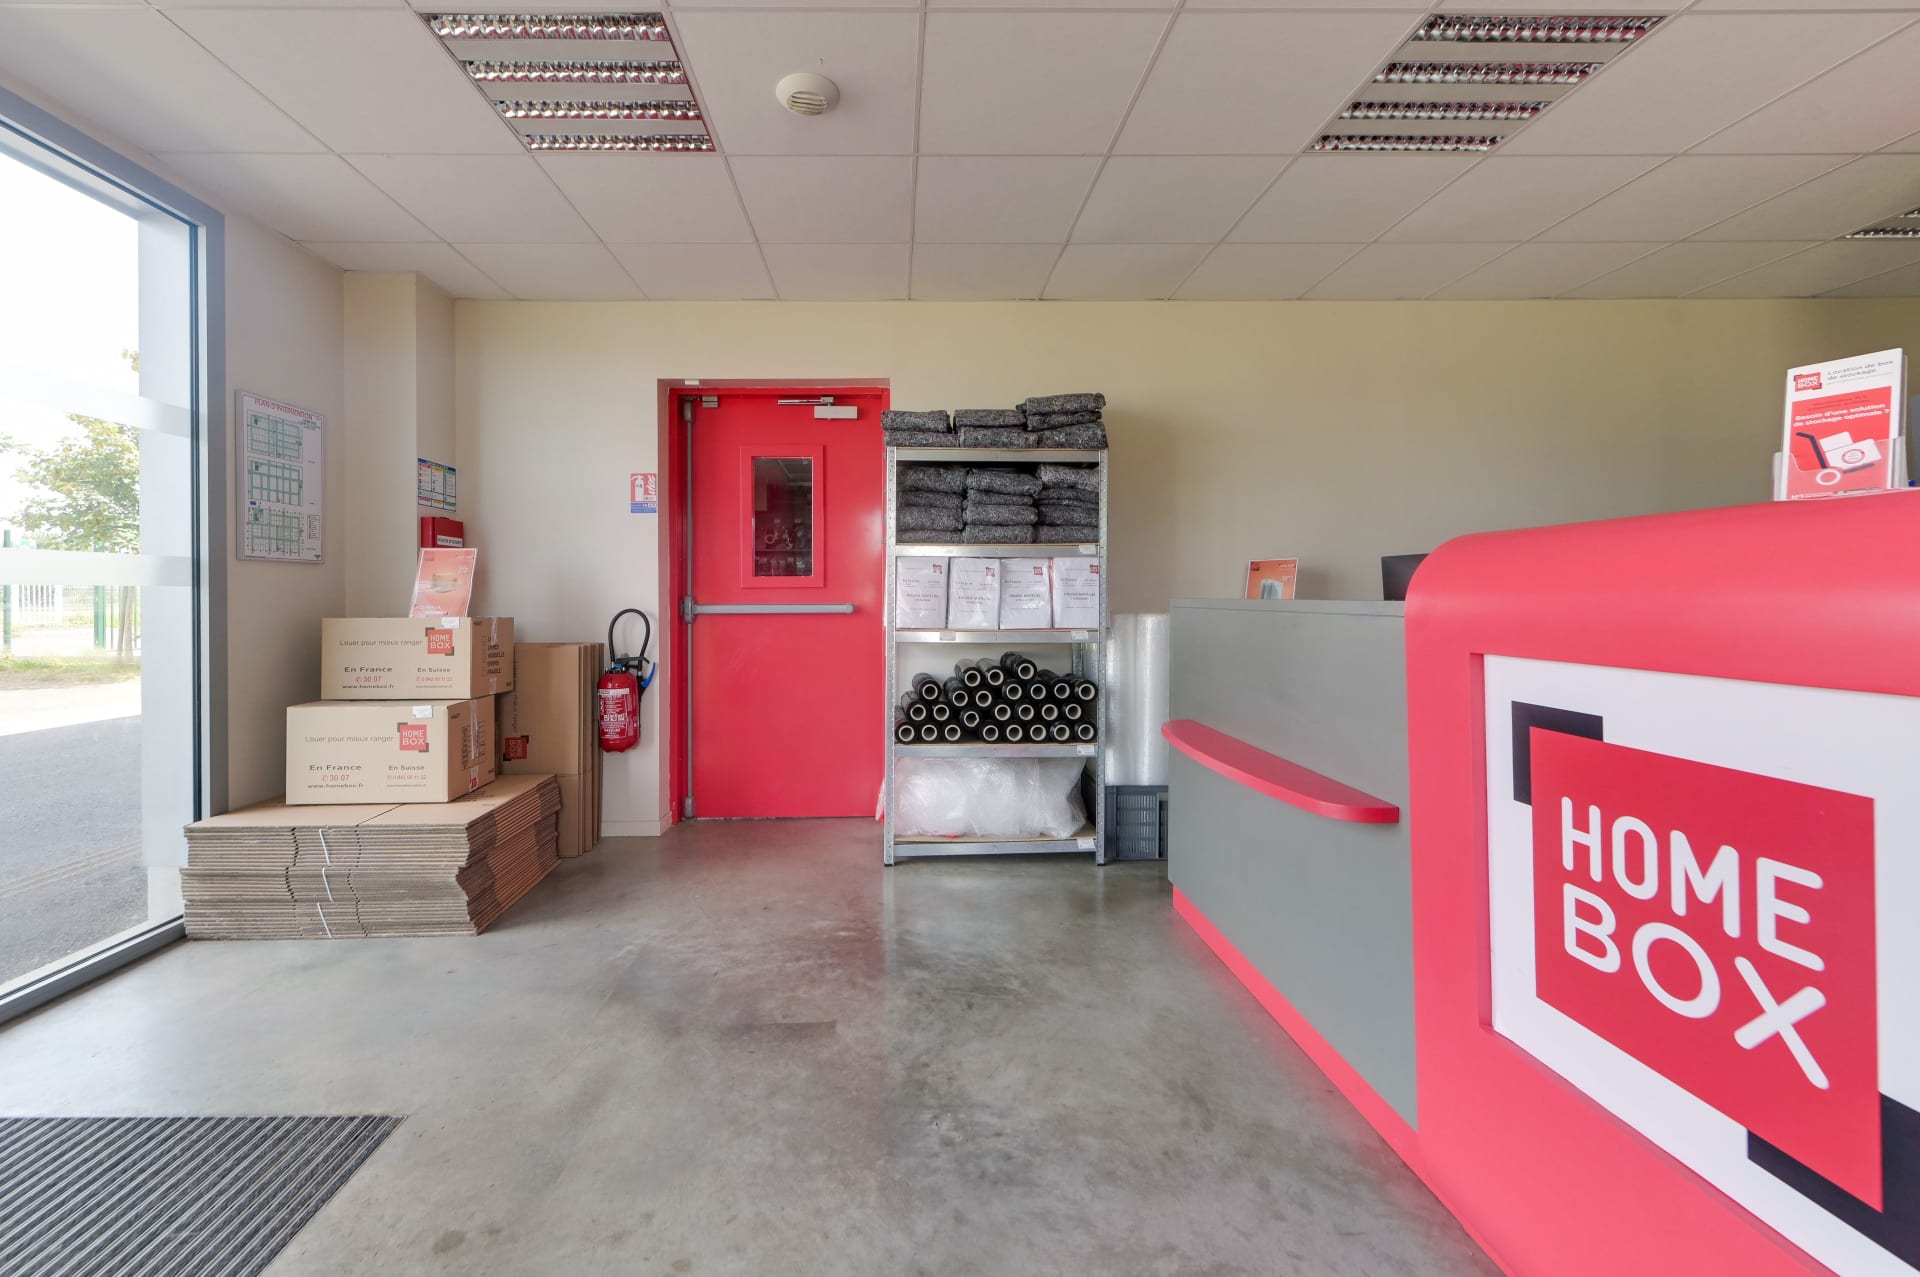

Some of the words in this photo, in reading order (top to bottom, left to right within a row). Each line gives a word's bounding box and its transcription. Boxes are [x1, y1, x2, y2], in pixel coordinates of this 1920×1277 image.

[1797, 375, 1819, 384] HOME
[1797, 381, 1819, 389] BOX
[1795, 412, 1823, 421] Besoin
[1824, 409, 1848, 417] d'une
[1850, 403, 1885, 413] solution
[1805, 416, 1842, 426] stockage
[1844, 409, 1882, 420] optimale
[401, 640, 422, 648] ranger
[430, 641, 451, 649] BOX
[402, 729, 425, 738] HOME
[370, 735, 394, 743] ranger
[402, 738, 425, 746] BOX
[1561, 796, 1825, 971] HOME
[1563, 882, 1830, 1091] BOX
